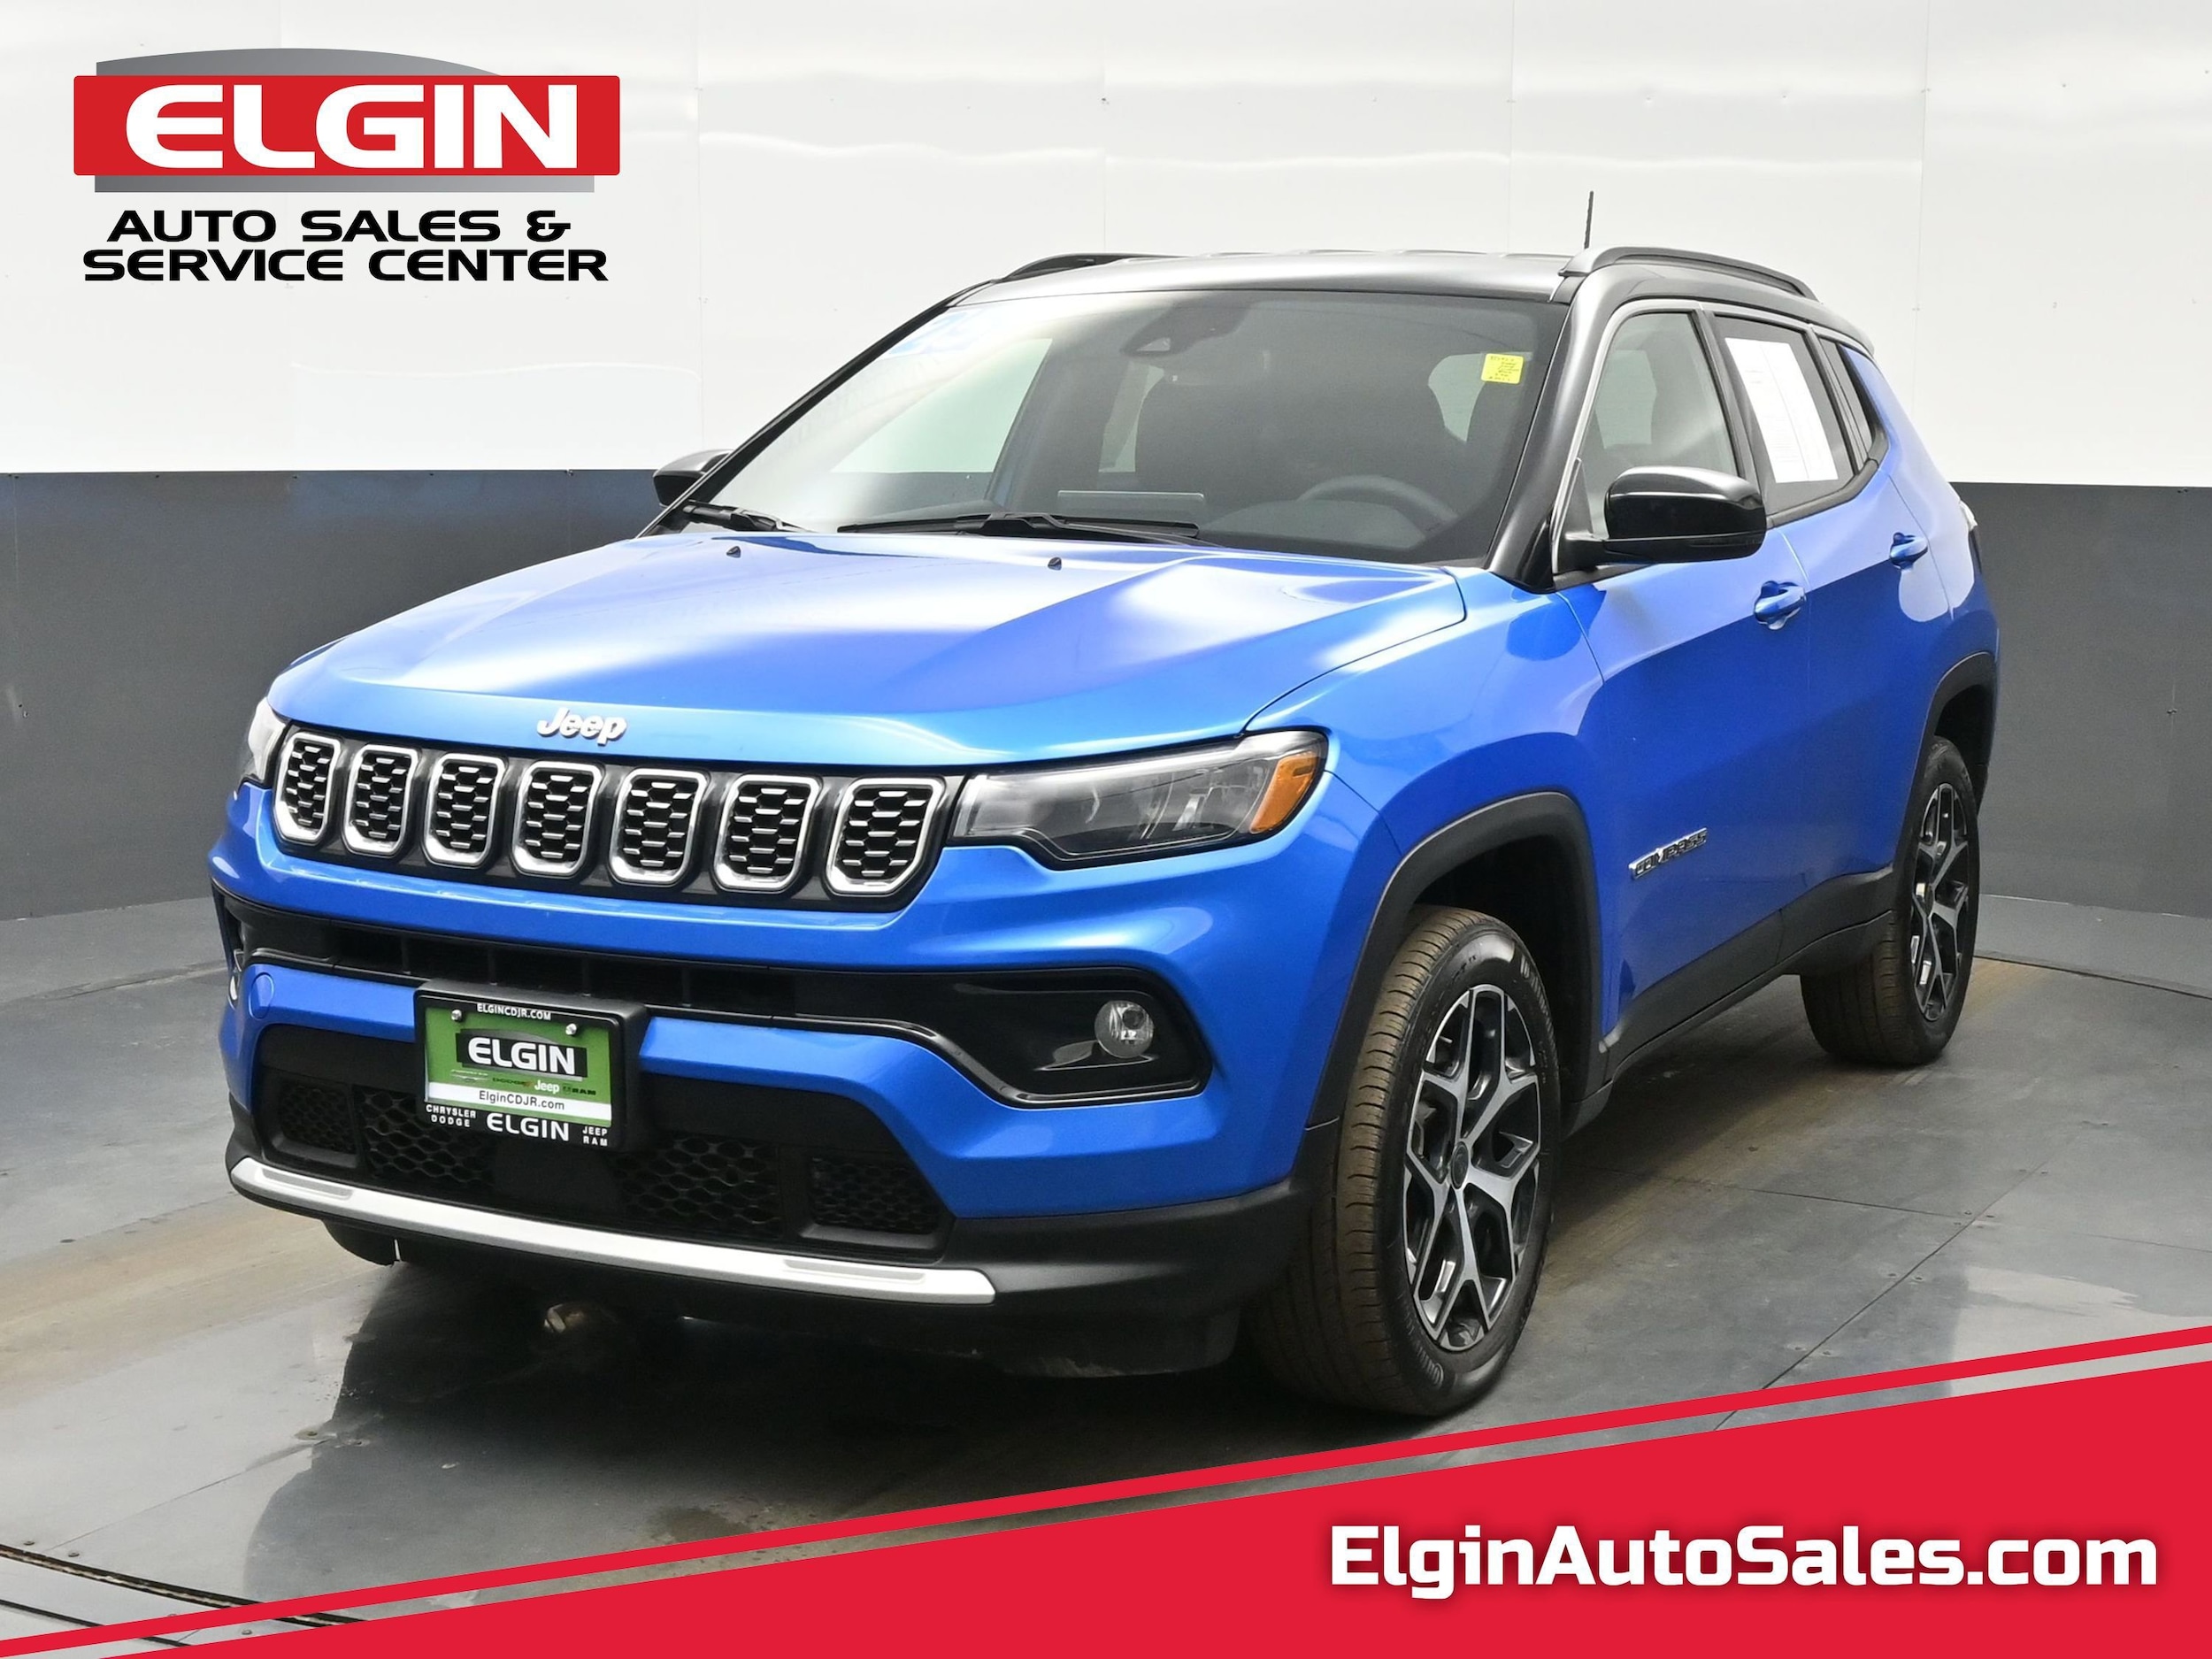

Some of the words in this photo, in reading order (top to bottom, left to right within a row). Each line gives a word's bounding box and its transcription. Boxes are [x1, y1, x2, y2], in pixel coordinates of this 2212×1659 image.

[536, 707, 627, 747] Jeep
[477, 1002, 552, 1021] ELGINCDJR.COM
[467, 1037, 576, 1075] ELGIN
[534, 1079, 560, 1094] Jeep
[479, 1090, 565, 1110] ElginCDJR.com
[426, 1104, 477, 1119] CHRYSLER
[431, 1115, 471, 1128] DODGE
[486, 1113, 570, 1141] ELGIN
[582, 1125, 608, 1136] JEEP
[582, 1136, 608, 1147] RAM
